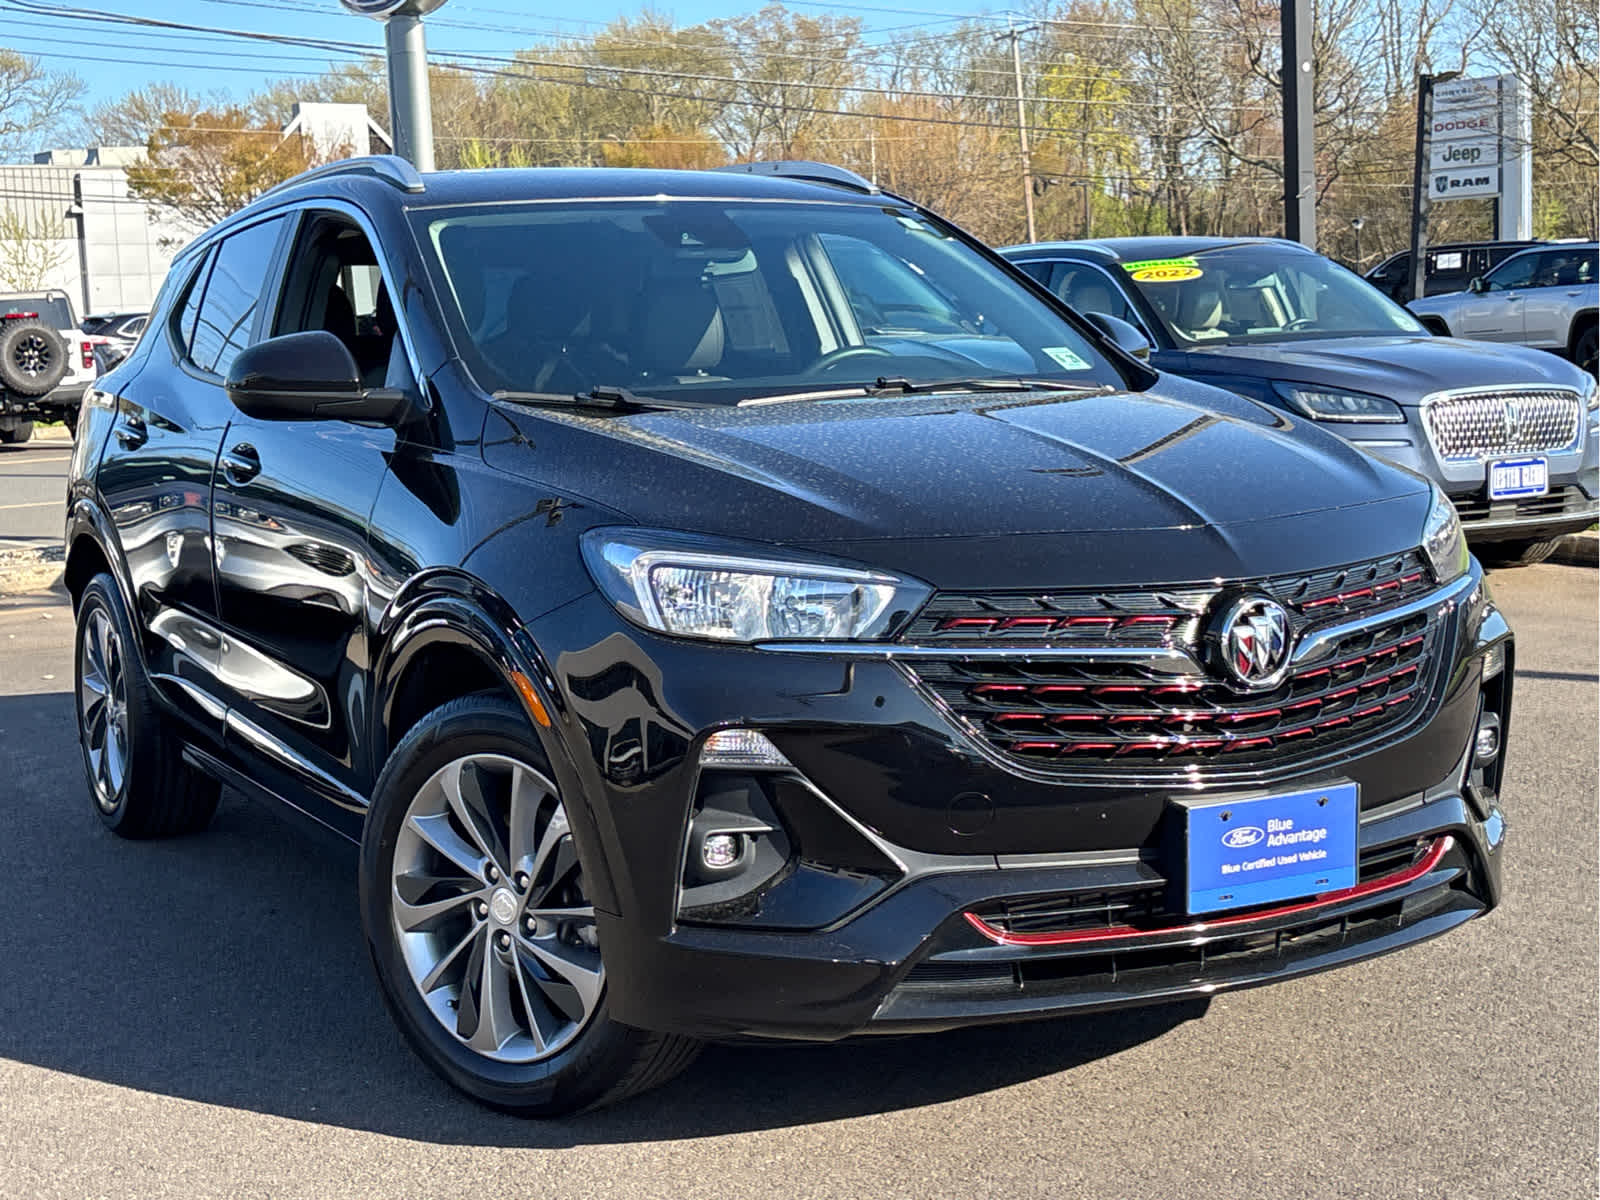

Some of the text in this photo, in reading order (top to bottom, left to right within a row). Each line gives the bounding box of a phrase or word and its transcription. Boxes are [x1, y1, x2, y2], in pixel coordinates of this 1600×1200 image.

[1434, 119, 1489, 133] DODGE
[1442, 145, 1481, 163] Jeep
[1450, 176, 1490, 188] RAM
[1143, 269, 1194, 279] 2022
[1267, 819, 1293, 833] Blue
[1267, 828, 1327, 848] Advantage
[1221, 849, 1327, 875] Blue Certified Used Vehicle
